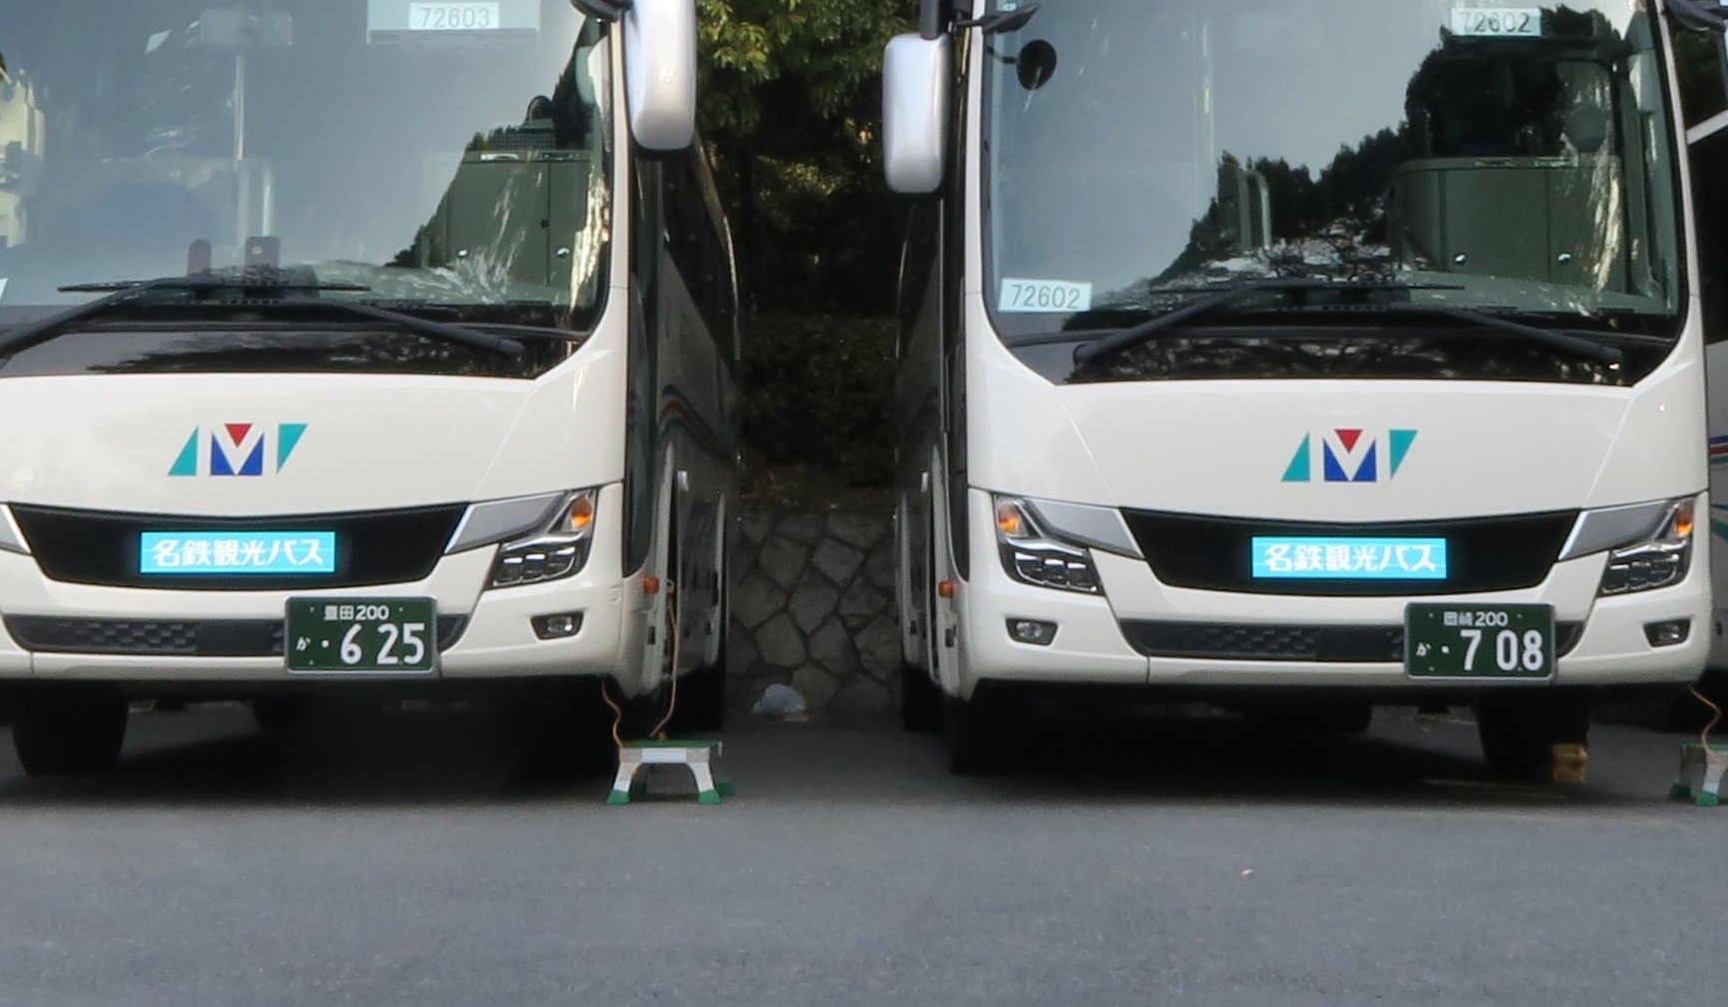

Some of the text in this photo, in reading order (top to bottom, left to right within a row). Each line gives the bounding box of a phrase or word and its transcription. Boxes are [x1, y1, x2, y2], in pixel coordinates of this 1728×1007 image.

[418, 7, 489, 28] 72603
[1459, 12, 1530, 32] 72602
[1011, 284, 1081, 309] 72602
[152, 539, 323, 567] 名鉄観光バス
[1264, 544, 1436, 572] 名鉄観光バス
